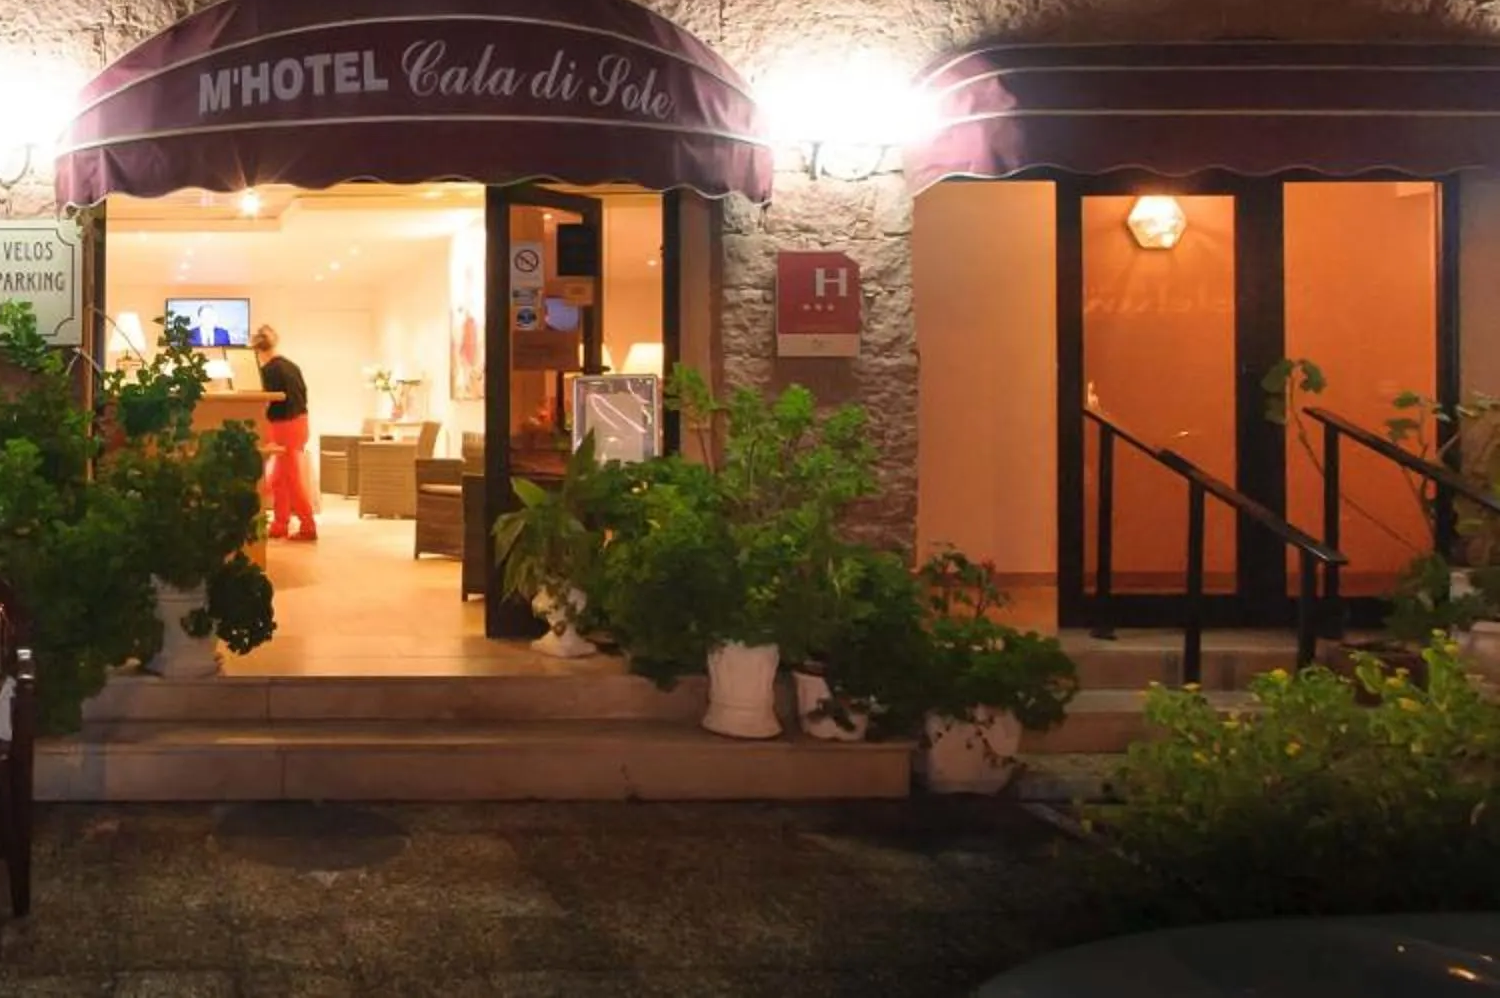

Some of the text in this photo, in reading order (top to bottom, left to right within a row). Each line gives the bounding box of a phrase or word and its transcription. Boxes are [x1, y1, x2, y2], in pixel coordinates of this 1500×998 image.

[199, 38, 678, 121] M'HOTEL Cala di Sole
[3, 241, 53, 261] VELOS
[815, 268, 847, 297] H
